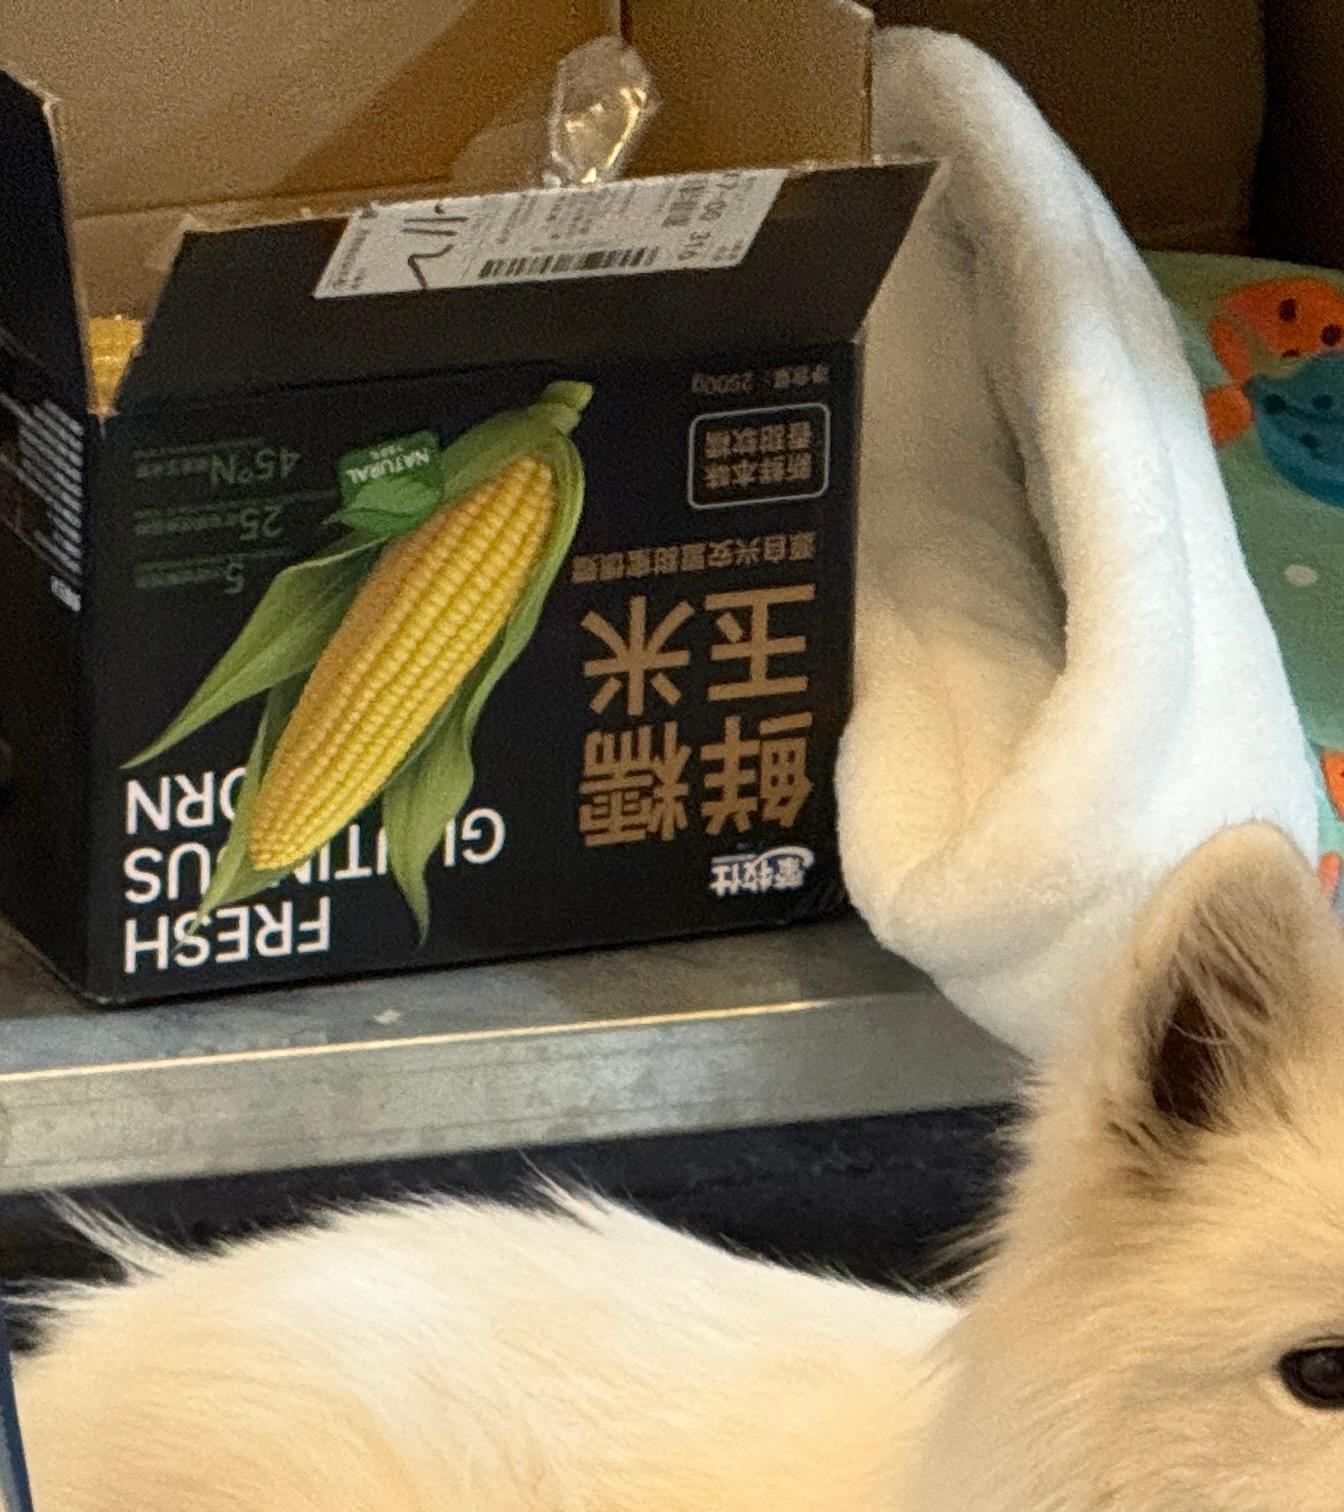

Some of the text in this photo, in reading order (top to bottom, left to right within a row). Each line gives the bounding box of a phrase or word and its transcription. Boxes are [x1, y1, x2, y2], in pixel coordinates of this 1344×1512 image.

[345, 448, 430, 484] NATURAL
[703, 451, 812, 489] 新鲜本味
[704, 421, 812, 458] 香甜软糯
[579, 583, 816, 717] 玉米
[125, 766, 247, 835] ORN
[578, 710, 813, 848] 鲜糯
[123, 896, 331, 974] FRESH
